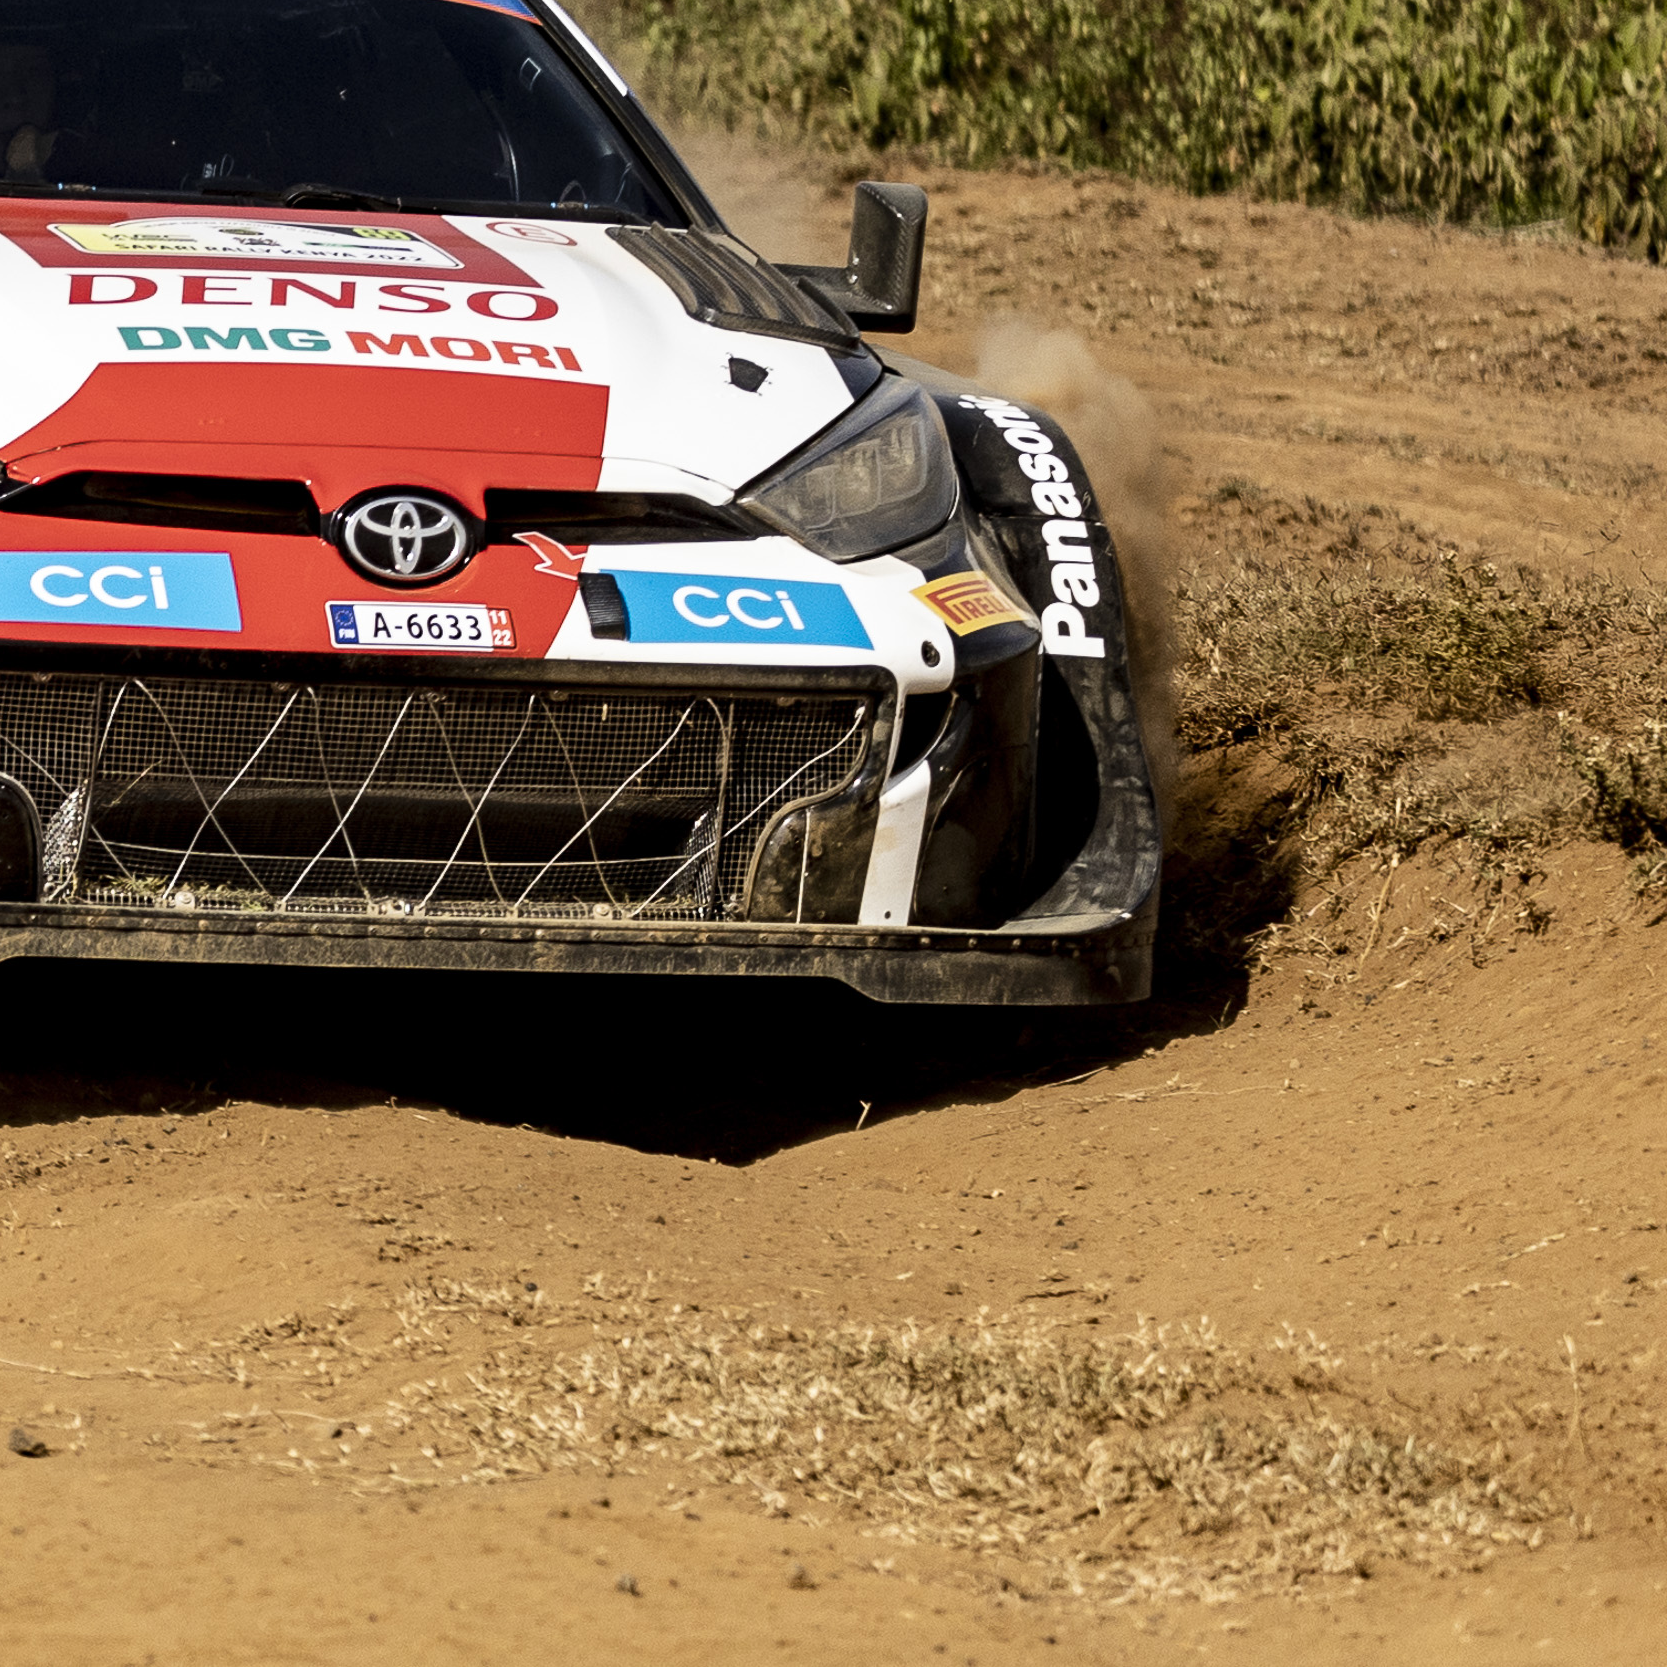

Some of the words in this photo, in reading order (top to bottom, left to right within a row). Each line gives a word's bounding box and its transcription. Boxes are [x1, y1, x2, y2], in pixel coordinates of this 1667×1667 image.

[114, 243, 198, 252] SAFARI
[203, 246, 273, 254] RALLY
[280, 248, 359, 258] KENYA
[365, 253, 427, 263] 2022
[67, 273, 559, 322] DENSO
[116, 326, 332, 352] DMG
[345, 331, 584, 373] MORI
[958, 394, 1106, 658] Panasonic
[373, 612, 482, 641] A-6633
[489, 610, 508, 625] 11
[493, 630, 512, 646] 22
